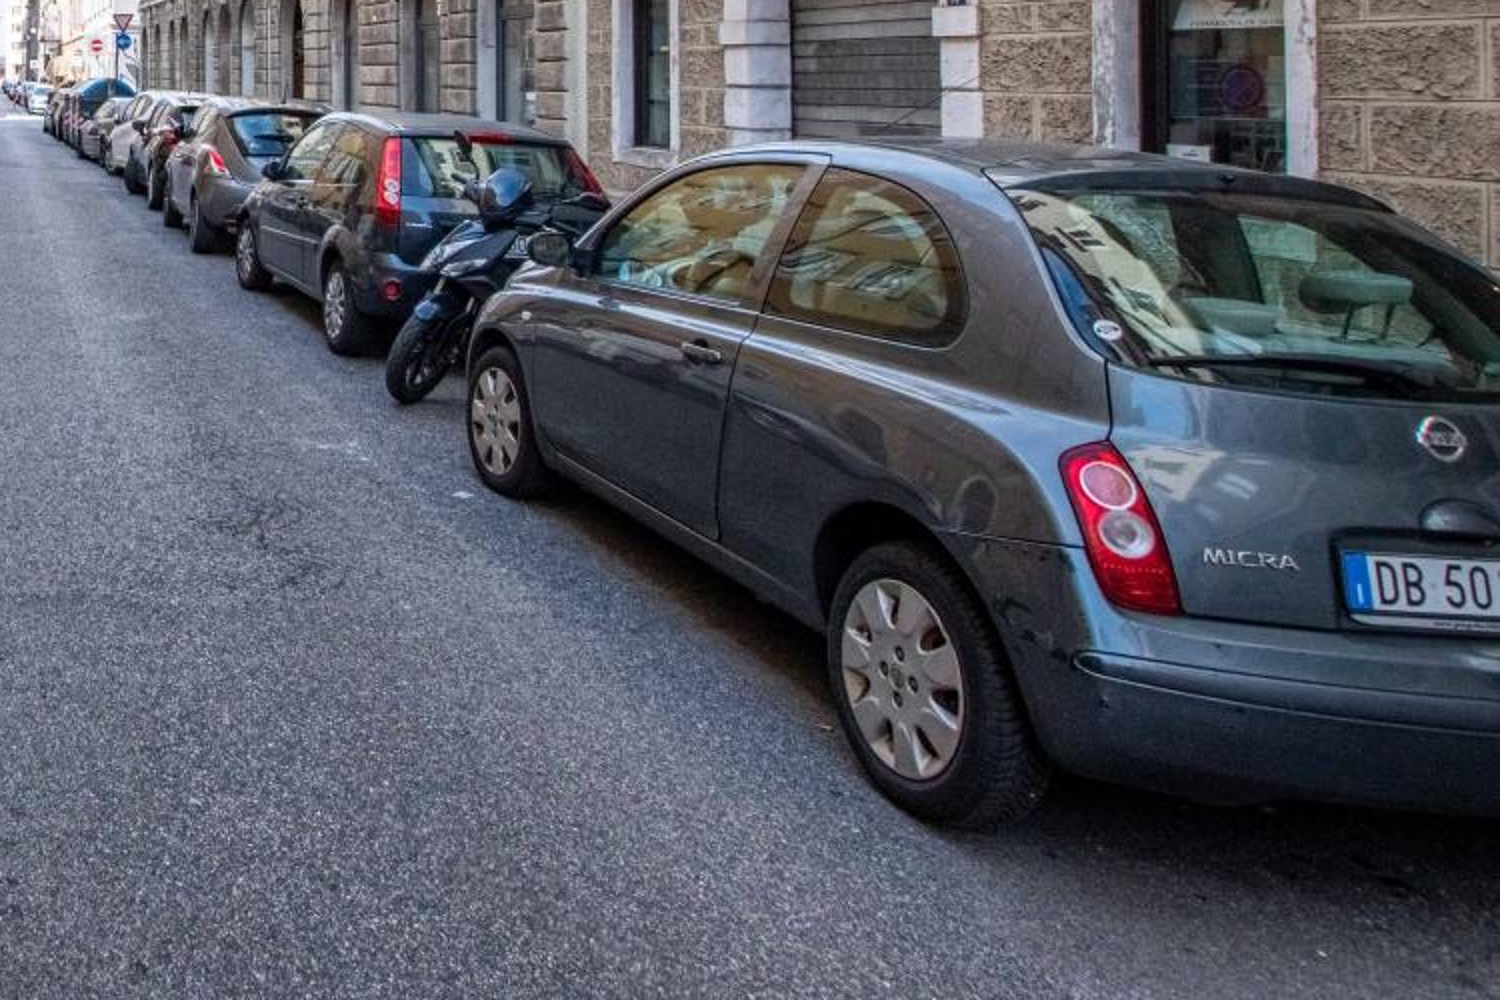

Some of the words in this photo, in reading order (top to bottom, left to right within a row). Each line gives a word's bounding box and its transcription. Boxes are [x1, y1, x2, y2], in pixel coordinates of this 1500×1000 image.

[1203, 548, 1300, 571] MICRA
[1374, 560, 1427, 607] DB
[1444, 564, 1500, 611] 50
